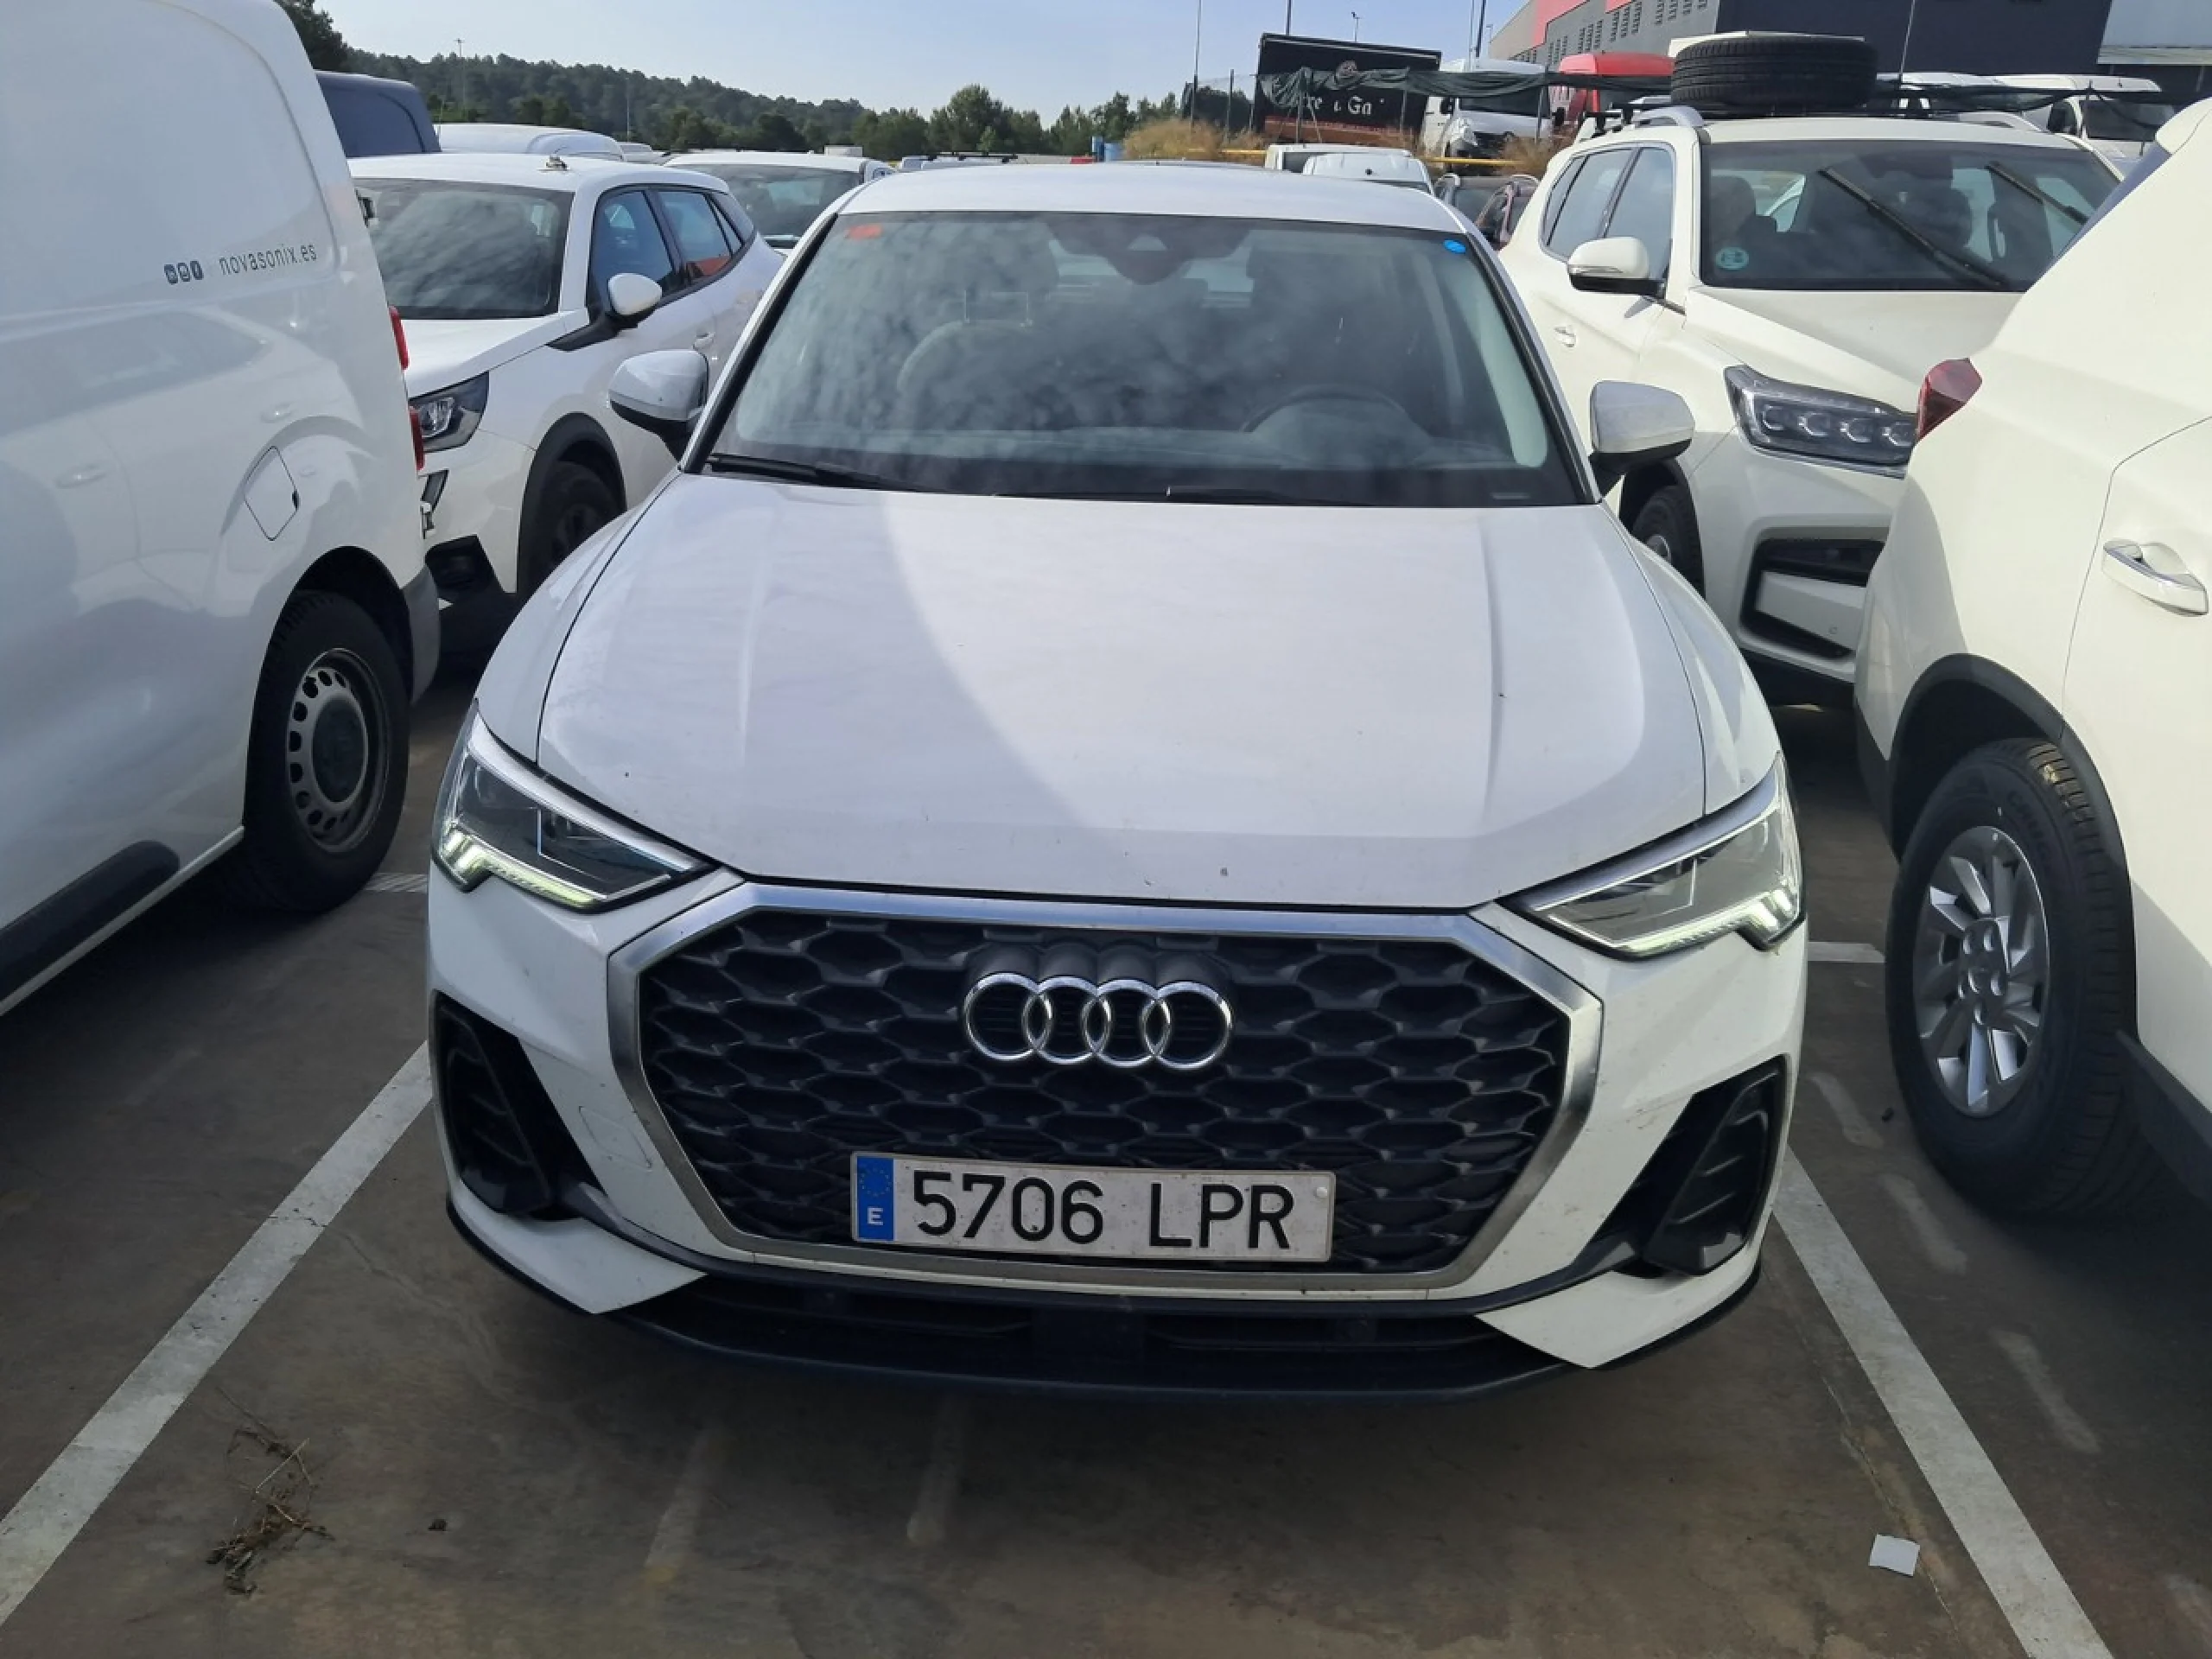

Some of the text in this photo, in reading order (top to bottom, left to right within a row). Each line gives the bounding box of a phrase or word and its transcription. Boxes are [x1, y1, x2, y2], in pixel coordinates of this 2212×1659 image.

[219, 243, 317, 276] novasonix.es
[867, 1168, 1295, 1251] E 5706 LPR
